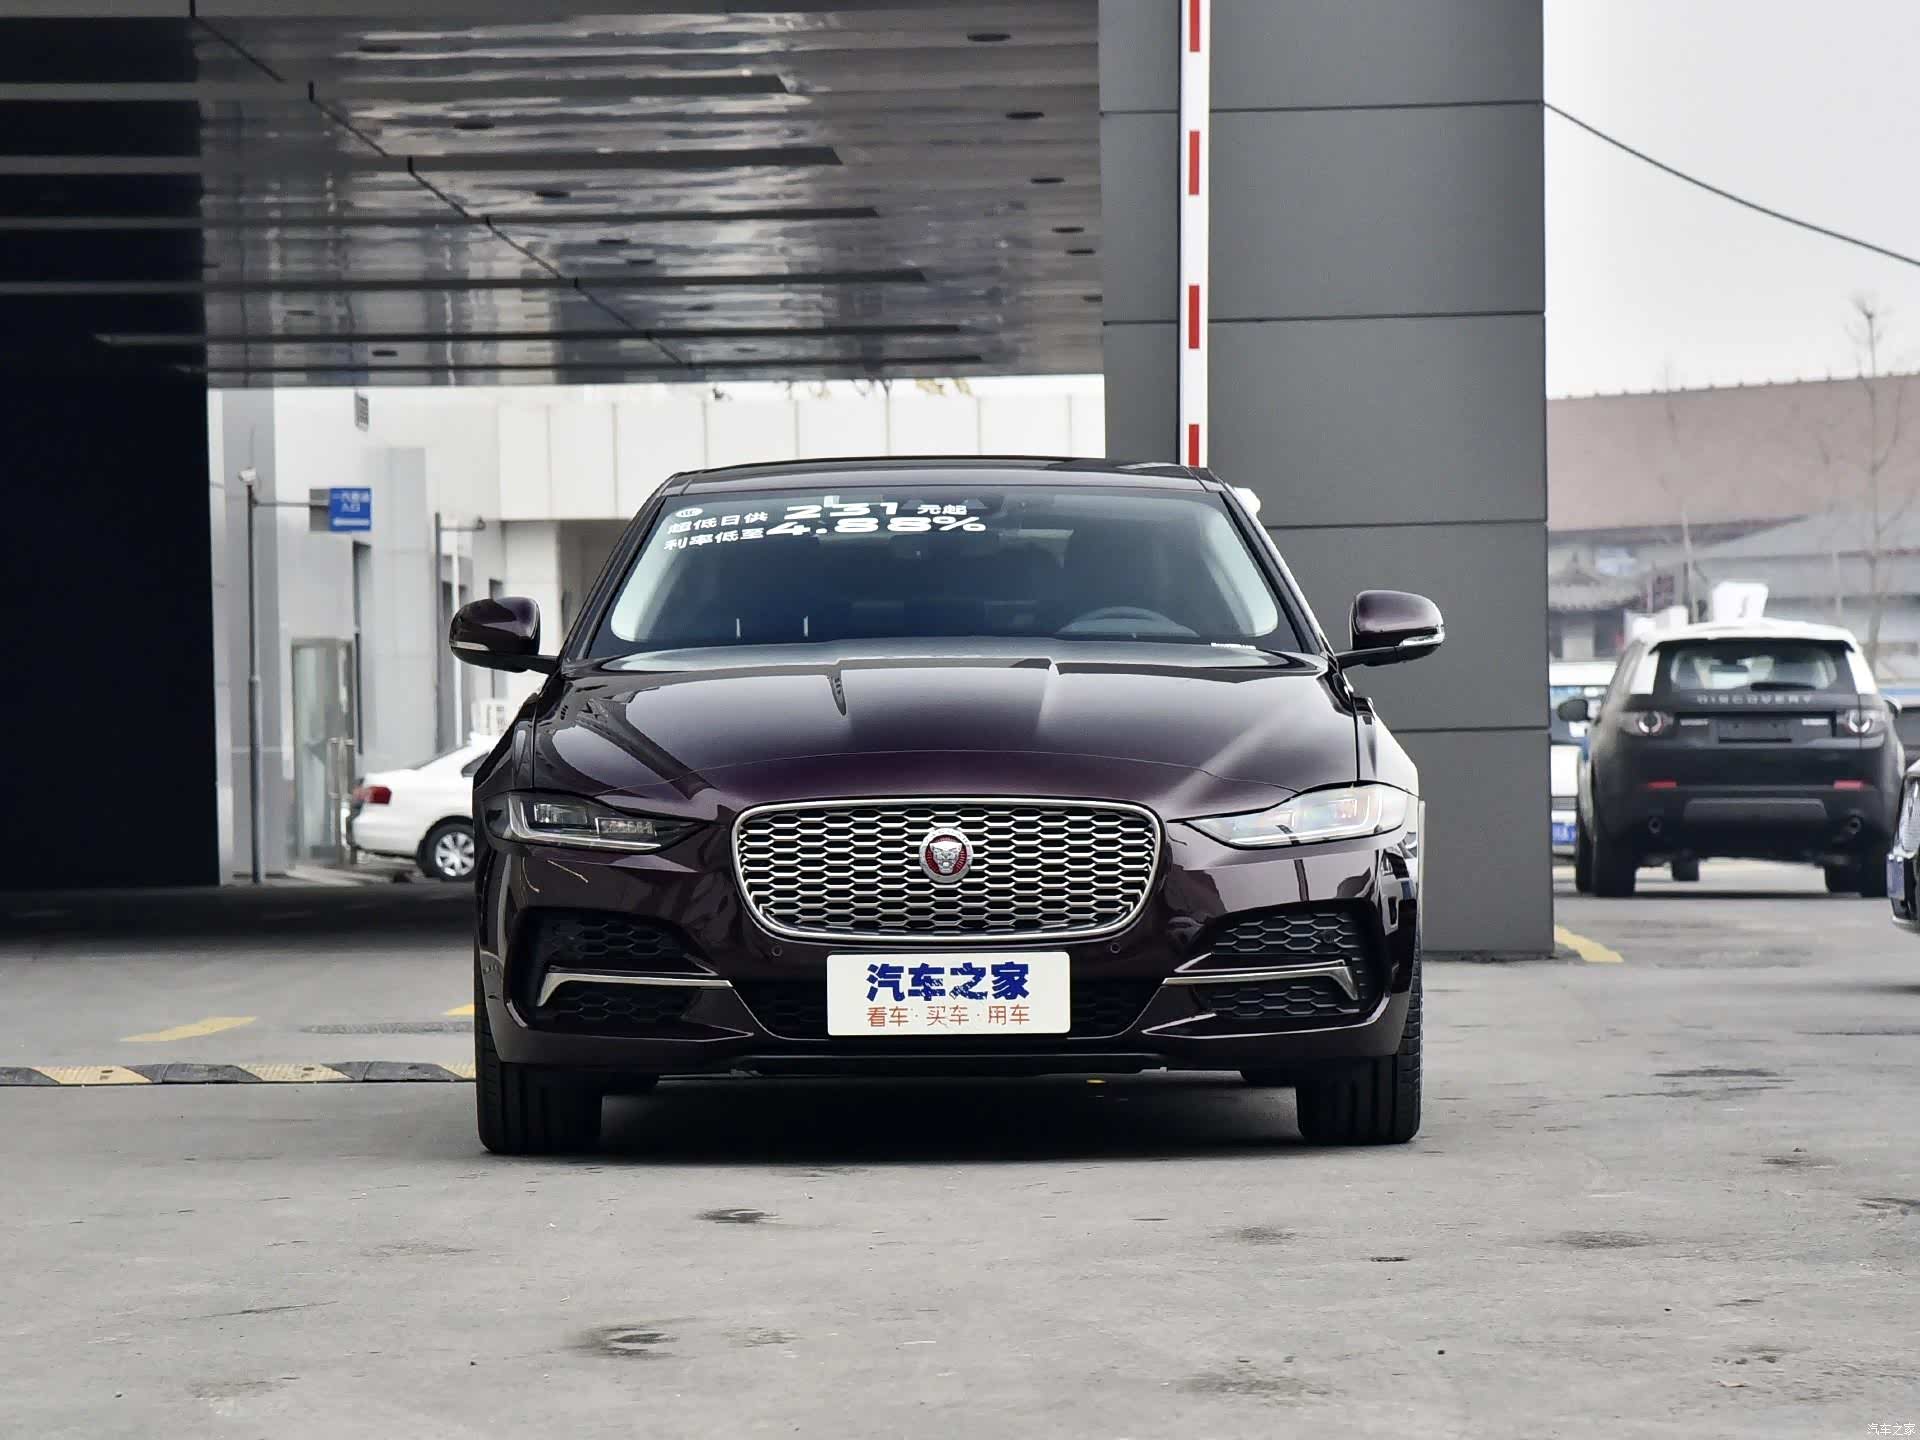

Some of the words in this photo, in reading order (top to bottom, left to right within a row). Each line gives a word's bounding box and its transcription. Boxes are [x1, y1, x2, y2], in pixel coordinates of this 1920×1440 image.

[664, 527, 765, 550] 利率低至
[766, 516, 987, 536] 4.88%
[667, 511, 769, 534] 超低日供
[866, 961, 1030, 1002] 汽车之家
